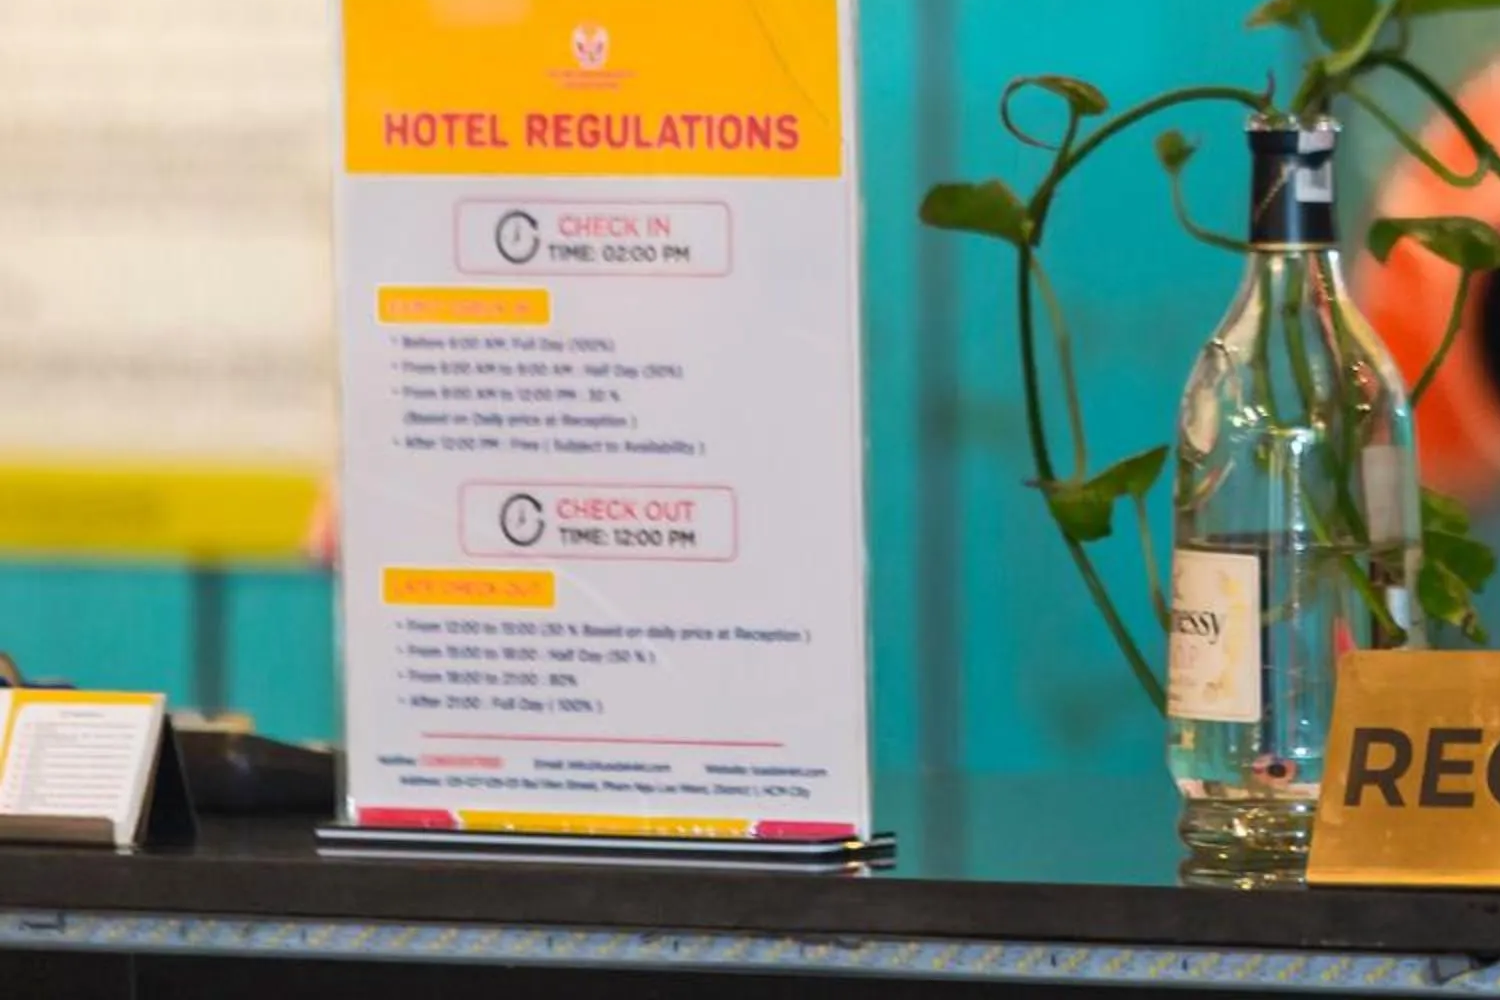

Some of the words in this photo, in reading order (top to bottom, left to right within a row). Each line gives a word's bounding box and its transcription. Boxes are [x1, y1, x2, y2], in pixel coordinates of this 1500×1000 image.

[385, 114, 508, 148] HOTEL
[525, 114, 800, 150] REGULATIONS
[557, 216, 639, 238] CHECK
[646, 217, 671, 238] IN
[548, 244, 595, 263] TIME:
[602, 245, 657, 263] 02:00
[663, 245, 691, 263] PM
[556, 500, 637, 522] CHECK
[645, 502, 695, 523] OUT
[558, 527, 609, 547] TIME:
[613, 529, 662, 548] 12:00
[668, 530, 696, 548] PM
